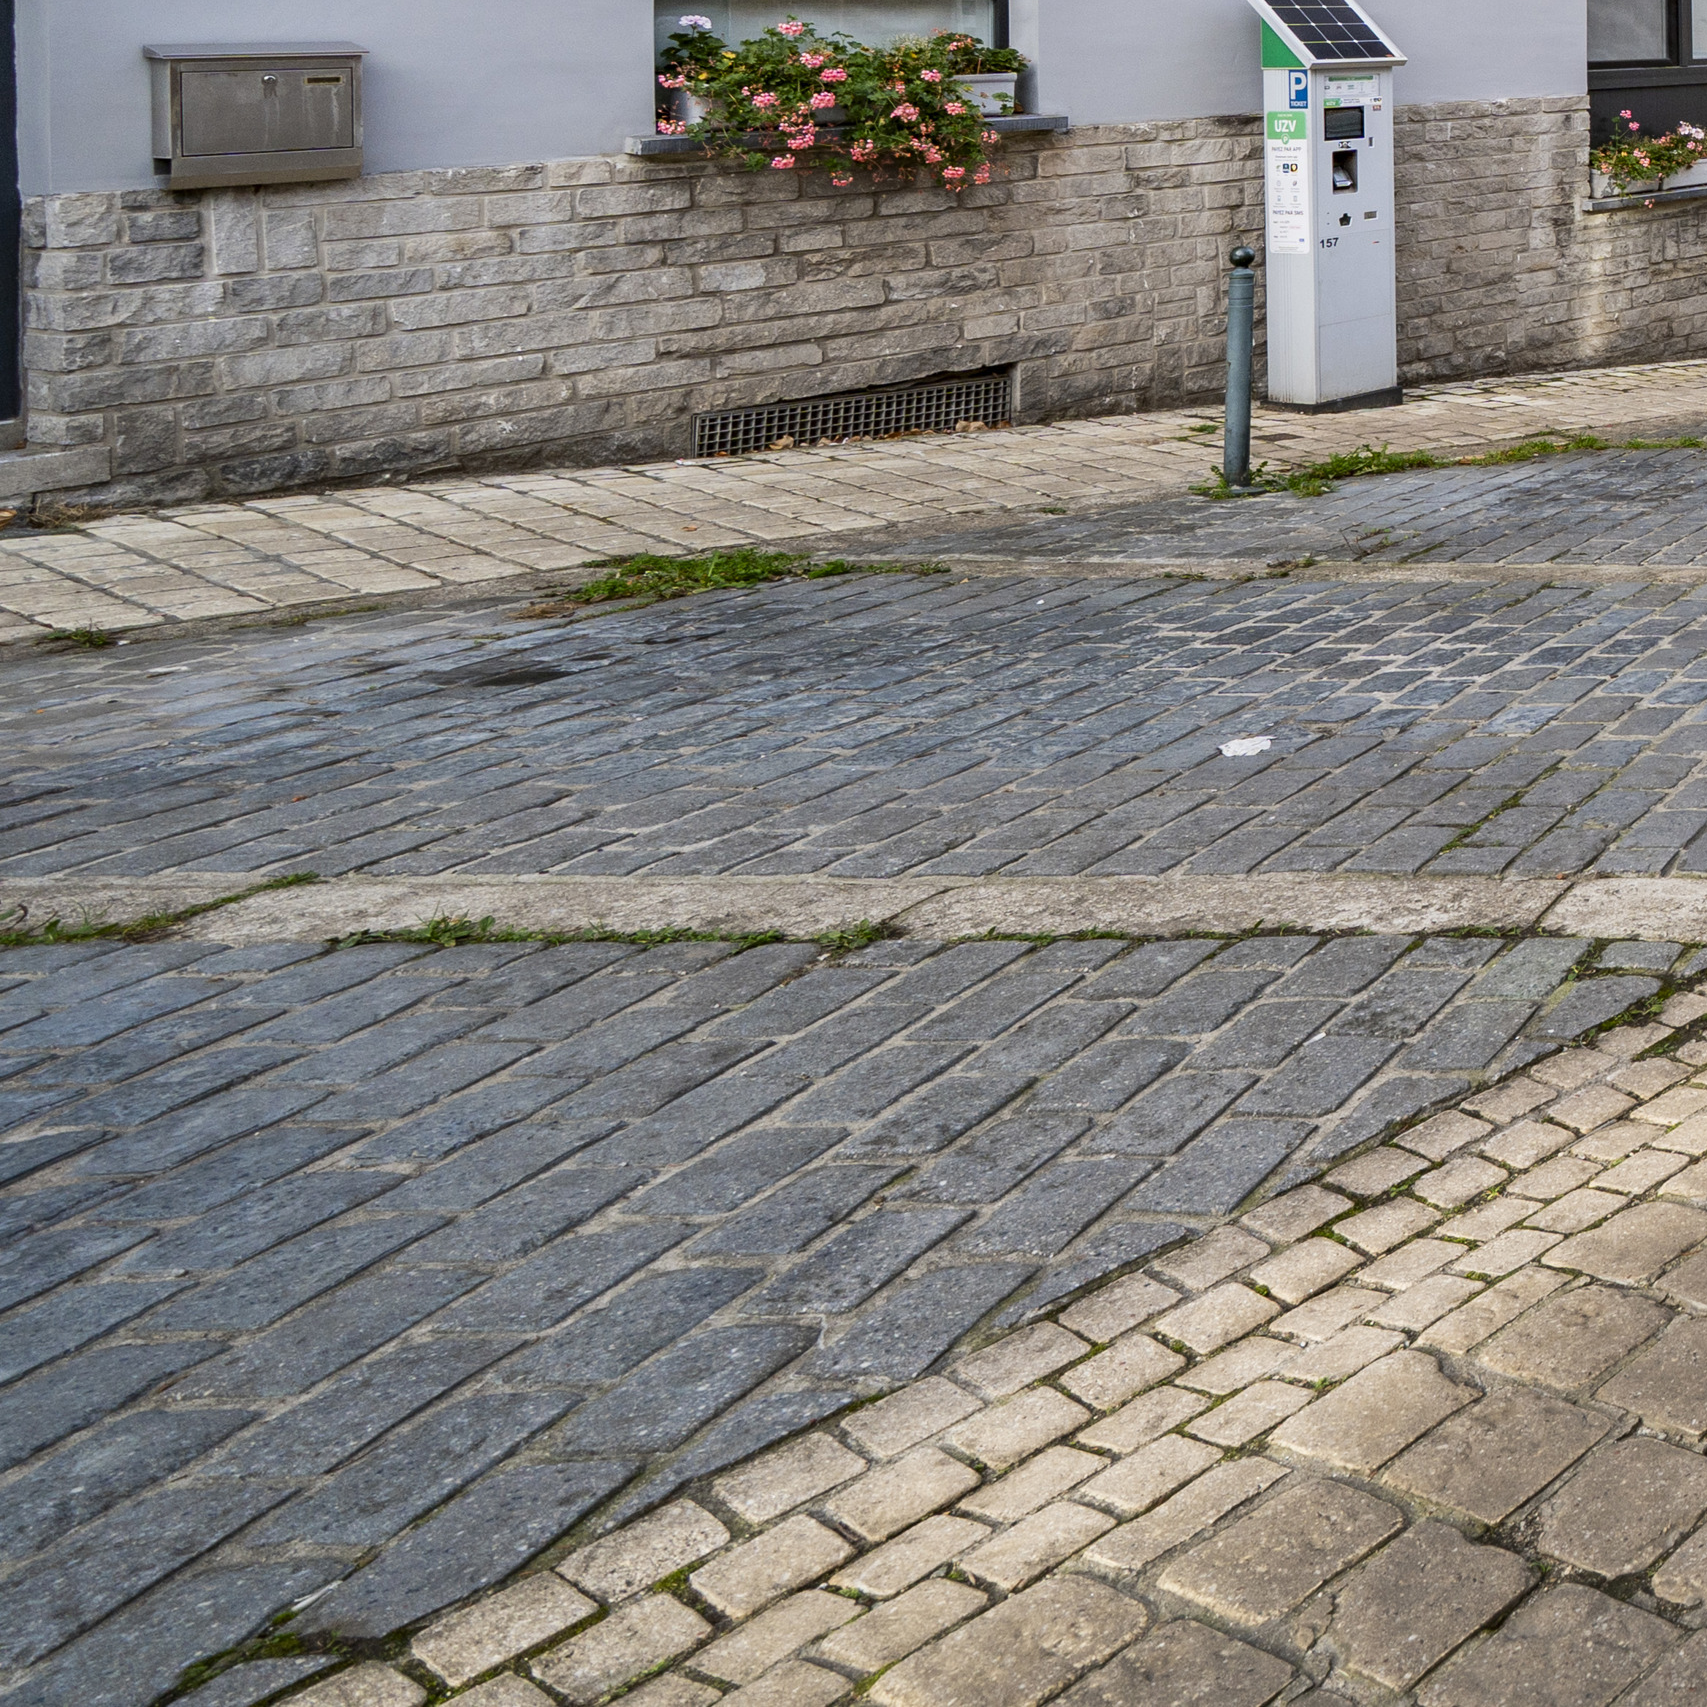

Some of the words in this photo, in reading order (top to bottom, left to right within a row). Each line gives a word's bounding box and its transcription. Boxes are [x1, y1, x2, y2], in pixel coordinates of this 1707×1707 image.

[1290, 72, 1307, 100] P
[1274, 119, 1297, 133] UZV
[1319, 236, 1339, 249] 157
